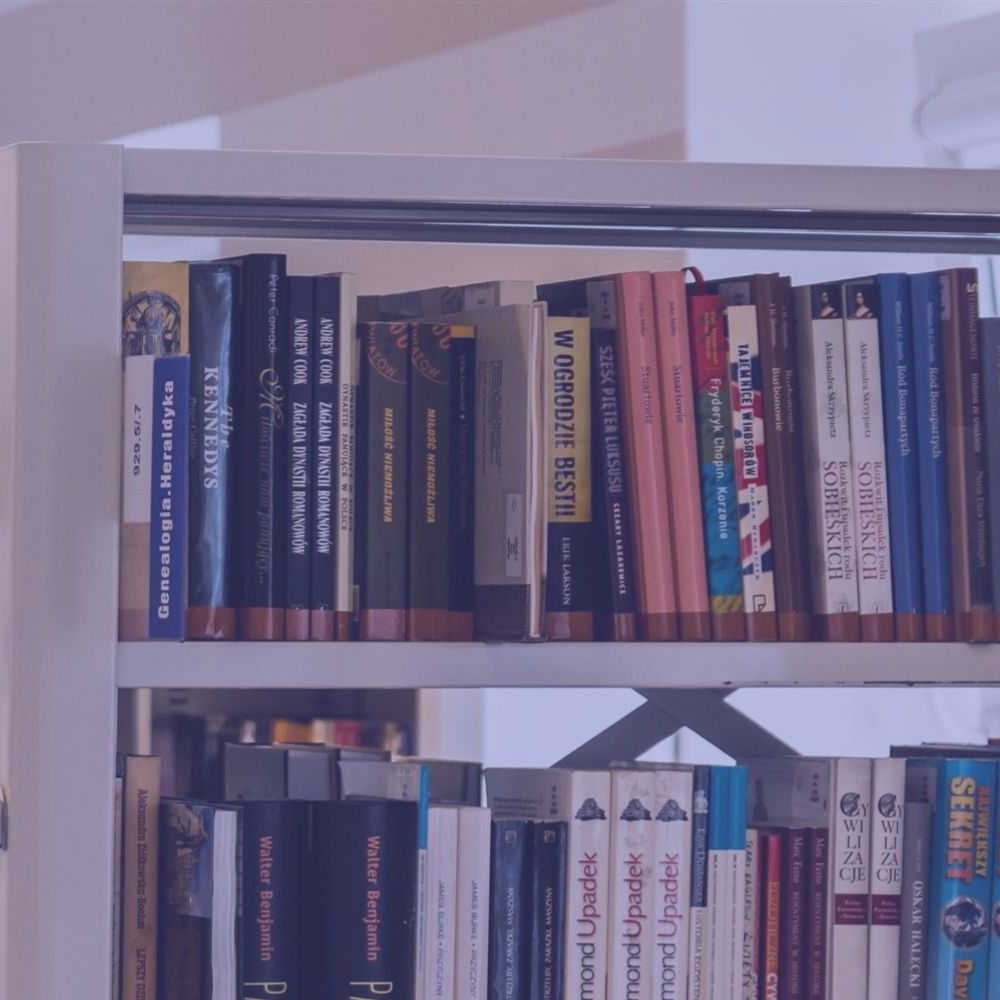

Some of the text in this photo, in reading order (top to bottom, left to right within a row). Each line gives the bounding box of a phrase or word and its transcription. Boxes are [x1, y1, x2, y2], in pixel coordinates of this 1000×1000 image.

[341, 383, 349, 427] DYNASTIE
[671, 365, 686, 424] Stuartowie
[824, 341, 836, 391] Aleksandra
[858, 341, 871, 391] Aleksandra
[203, 367, 218, 489] KENNEDYS
[291, 318, 308, 555] ANDREW COOK ZAGŁADA DYNASTII ROMANOWÓW
[317, 318, 334, 554] ANDREW COOK ZAGŁADA DYNASTII ROMANOWÓW
[554, 329, 576, 517] W OGRODZIE BESTII
[737, 343, 757, 476] TAJEMNICE WINDSORÓW
[342, 483, 348, 491] W
[383, 407, 395, 523] MIŁOŚĆ NIEMOŻLIWA
[426, 408, 438, 523] MIŁOŚĆ NIEMOŻLIWA
[604, 436, 621, 493] LUKSUSU
[707, 378, 723, 433] Fryderyk
[716, 487, 730, 540] Korzenie
[822, 461, 844, 580] SOBIESKICH
[856, 461, 878, 580] SOBIESKICH
[562, 563, 572, 605] LARSON
[843, 552, 855, 580] rodu
[877, 552, 889, 580] rodu
[947, 776, 976, 881] SEKRET
[256, 835, 275, 961] Walter Benjamin
[363, 835, 381, 961] Walter Benjamin
[576, 852, 598, 937] Upadek
[622, 853, 643, 938] Upadek
[657, 853, 682, 937] Upadek
[911, 880, 923, 925] OSKAR
[909, 930, 922, 987] HALECKI
